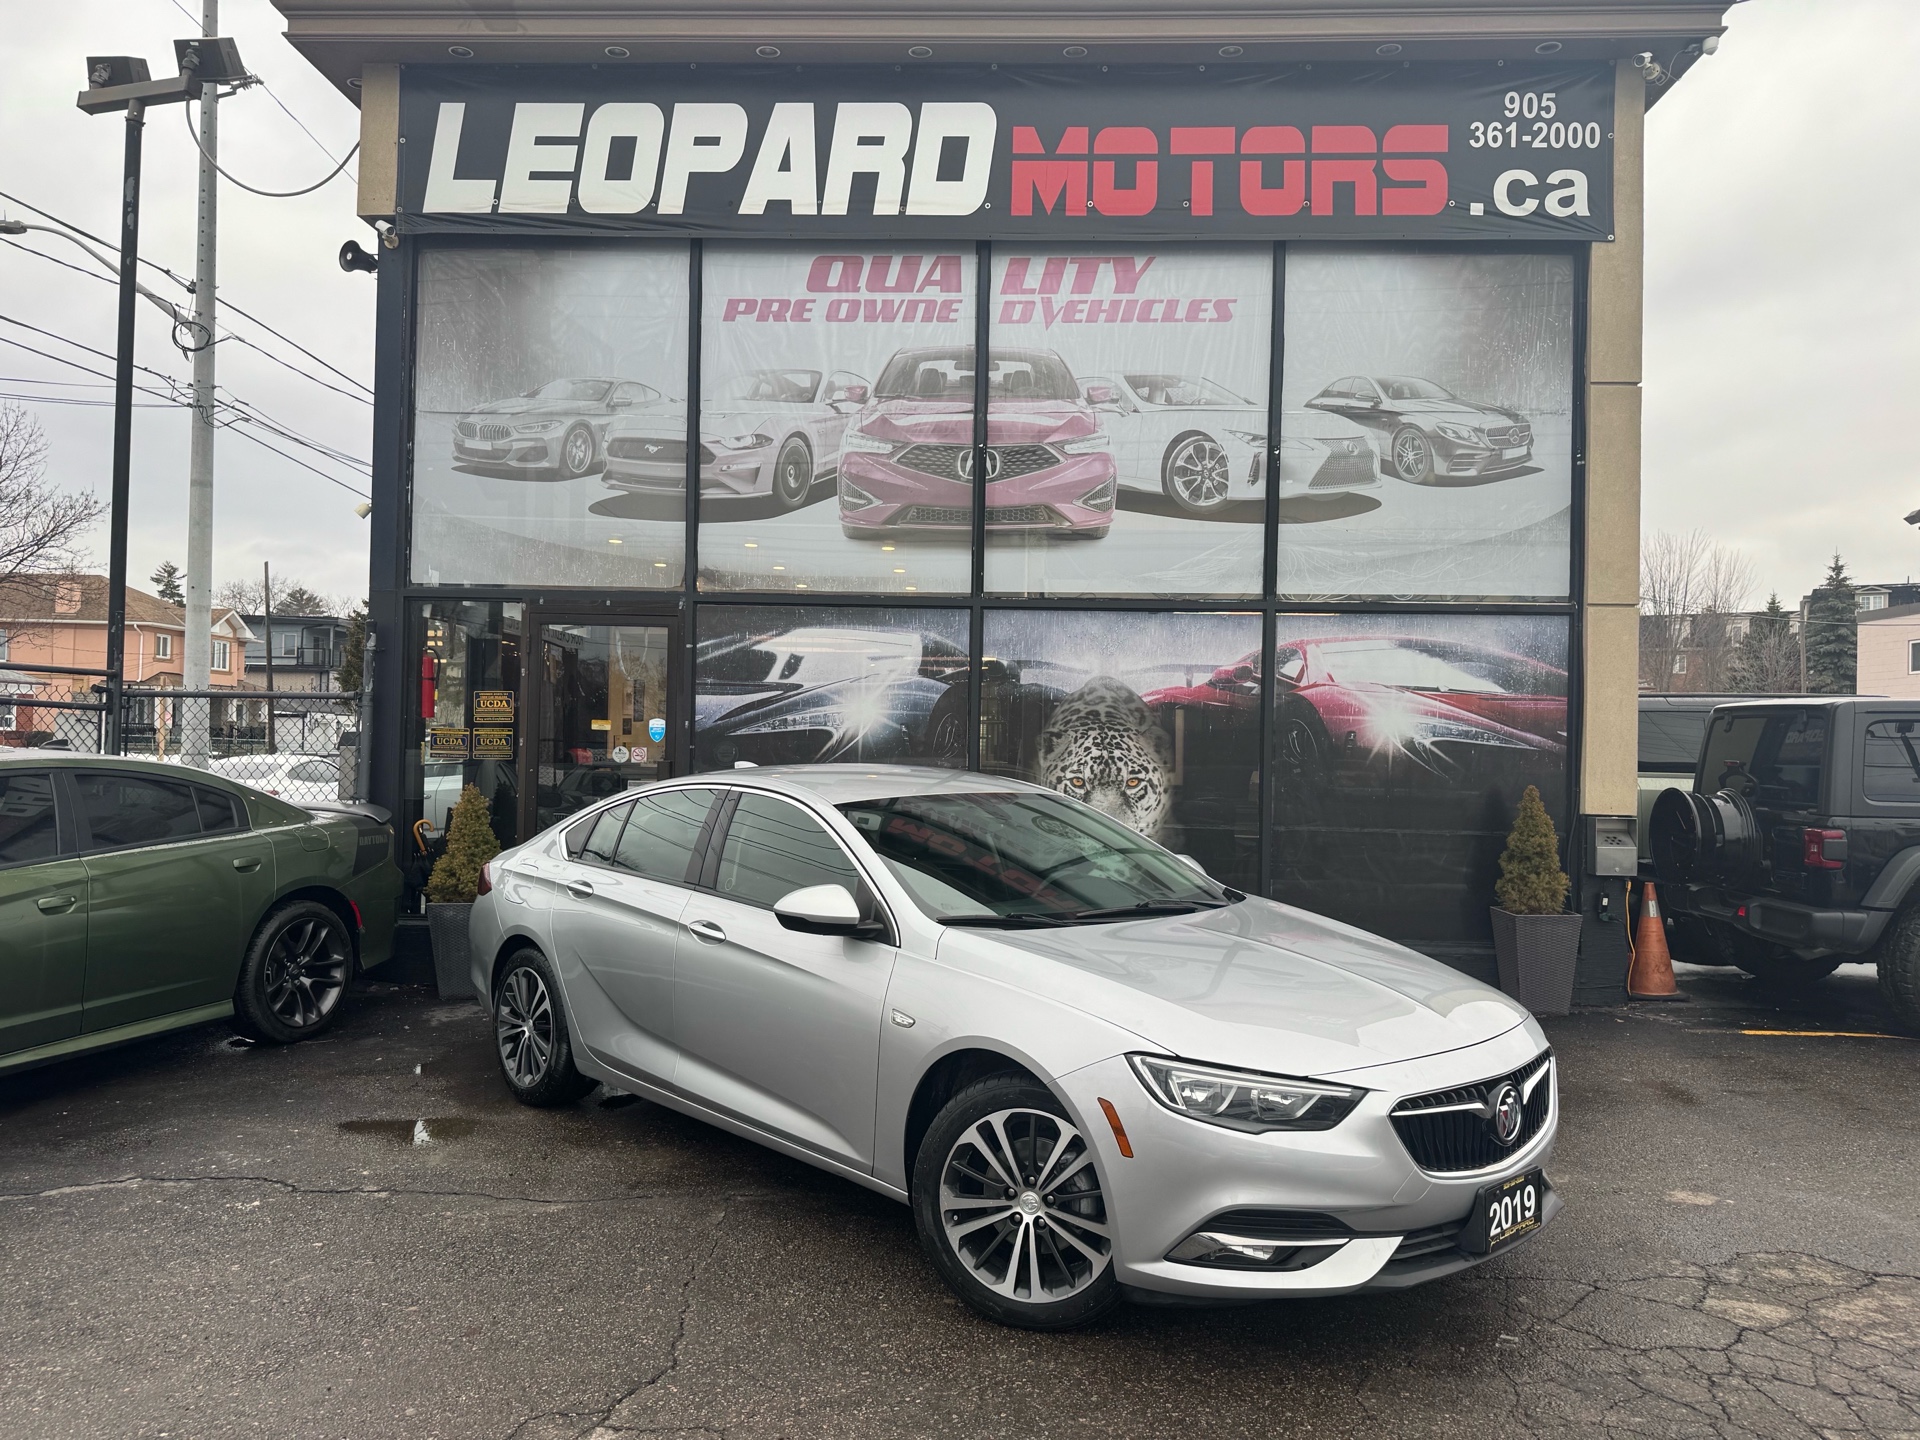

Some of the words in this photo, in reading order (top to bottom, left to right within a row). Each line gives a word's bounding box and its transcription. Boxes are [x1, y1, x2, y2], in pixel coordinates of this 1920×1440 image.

[1504, 91, 1556, 119] 905
[1469, 121, 1601, 149] 361-2000
[422, 102, 997, 216] LEOPARD
[1011, 124, 1449, 217] MOTORS
[1469, 169, 1591, 217] .ca
[805, 255, 962, 293] QUA
[999, 256, 1157, 295] LITY
[722, 298, 817, 322] PRE
[825, 298, 964, 323] OWNE
[480, 700, 508, 708] UCDA
[436, 738, 463, 746] UCDA
[480, 738, 507, 746] UCDA
[359, 834, 389, 846] DAYTONA
[1489, 1184, 1536, 1237] 2019
